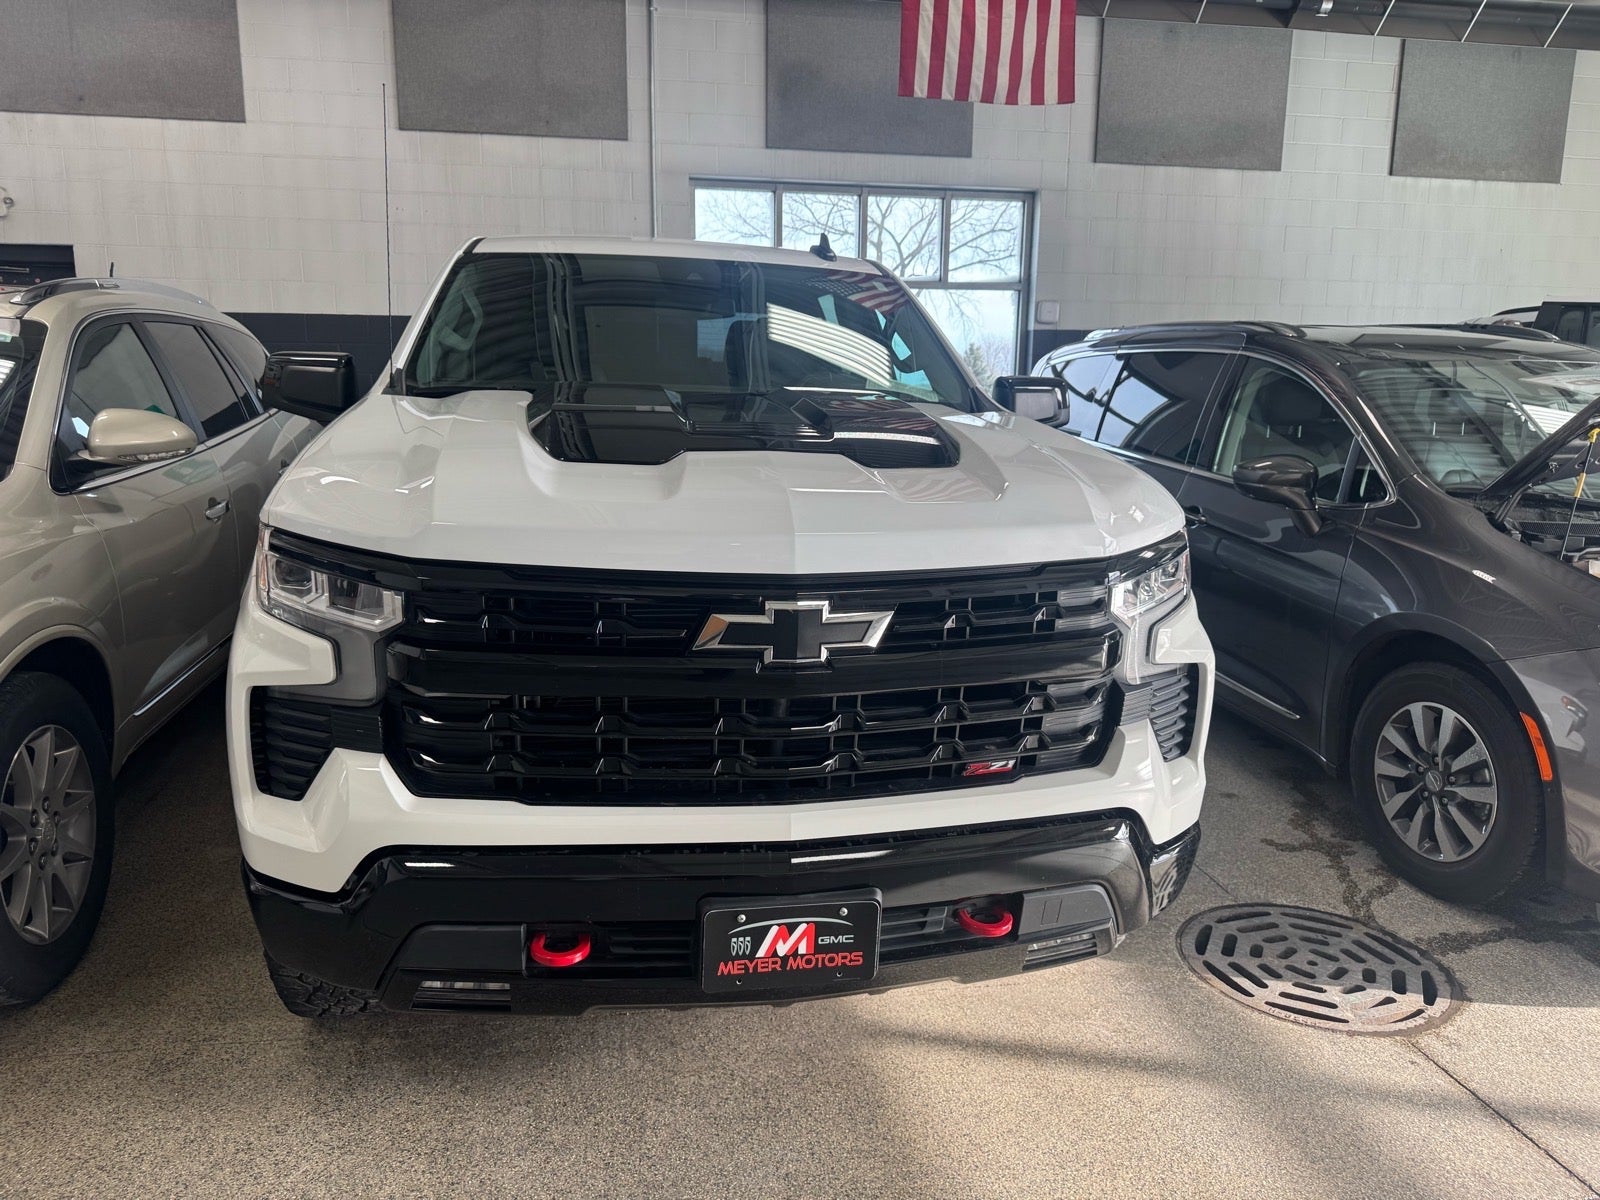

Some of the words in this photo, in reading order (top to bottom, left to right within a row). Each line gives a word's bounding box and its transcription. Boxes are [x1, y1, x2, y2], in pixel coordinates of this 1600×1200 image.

[755, 922, 815, 958] M
[818, 935, 854, 944] GMC
[717, 957, 781, 976] MEYER
[787, 951, 864, 971] MOTORS
